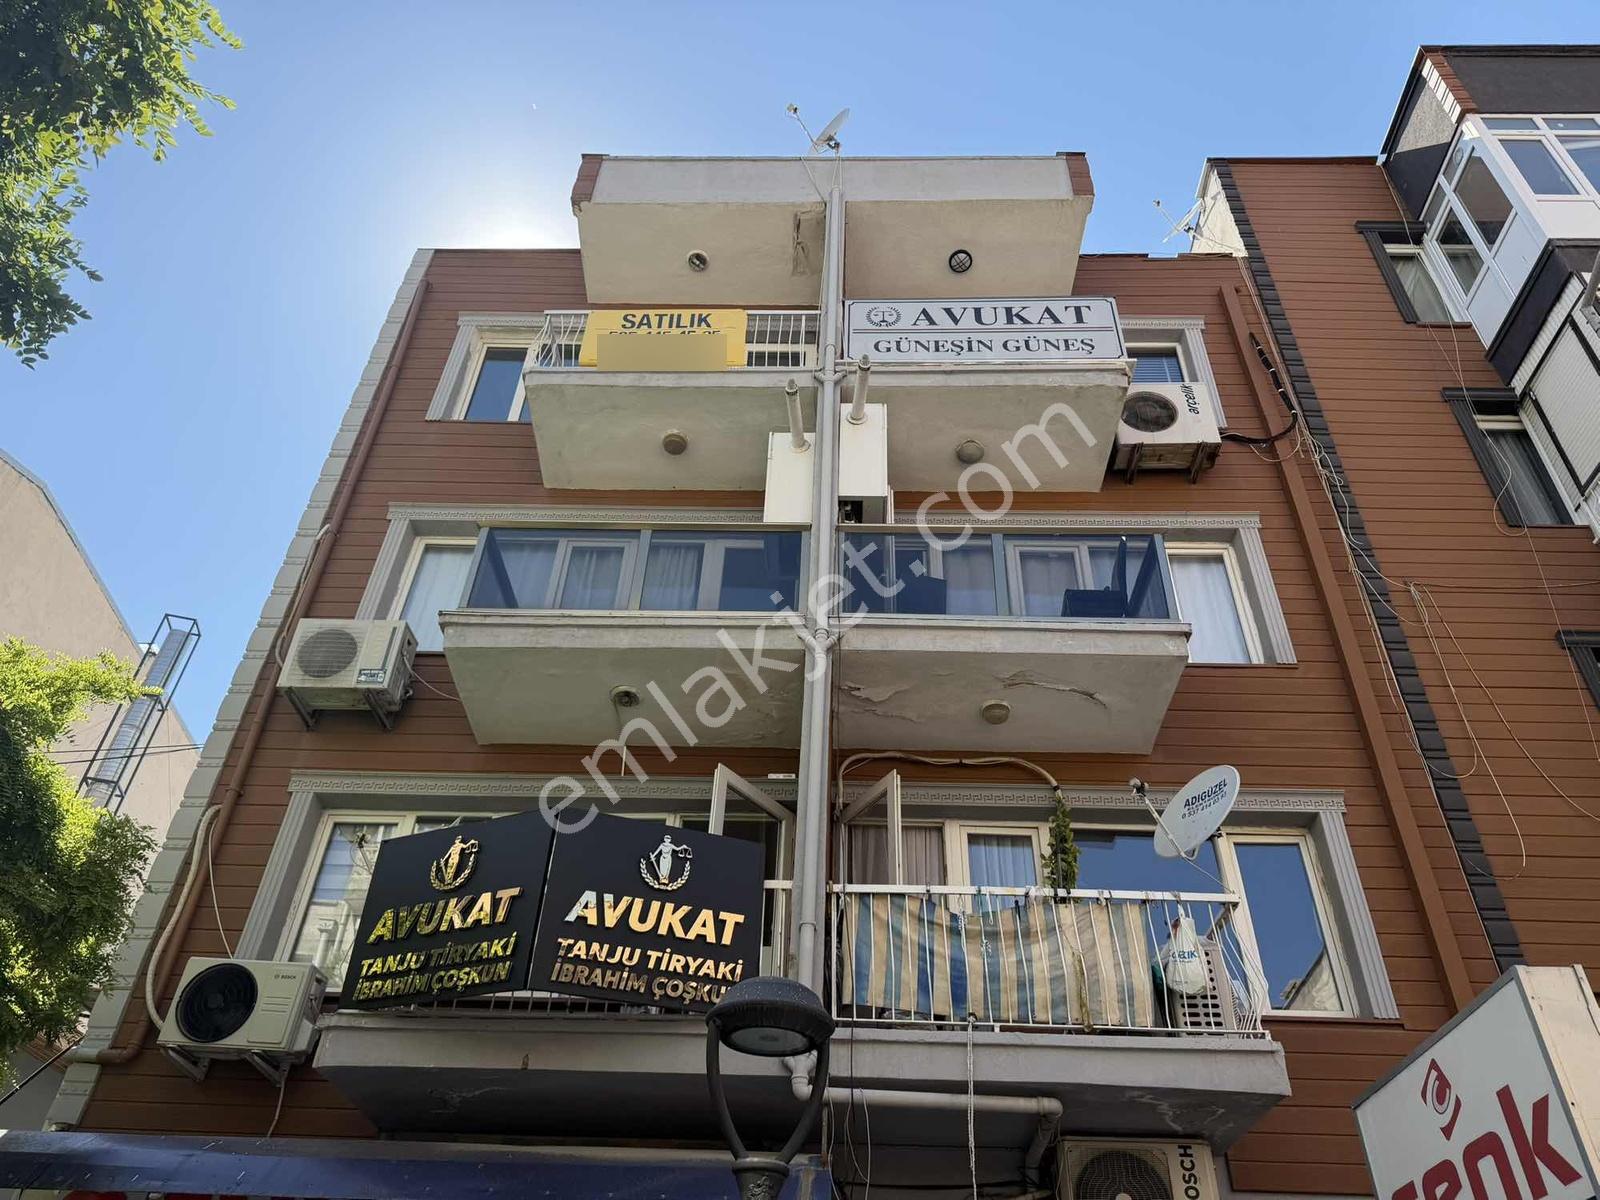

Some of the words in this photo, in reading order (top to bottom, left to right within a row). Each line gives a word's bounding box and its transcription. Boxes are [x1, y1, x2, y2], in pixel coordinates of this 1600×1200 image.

[621, 312, 713, 329] SATILIK
[912, 304, 1093, 327] AVUKAT
[873, 336, 994, 356] GÜNEŞİN
[1002, 335, 1096, 355] GÜNEŞ
[1183, 777, 1228, 809] ADIGÜZEL
[366, 886, 525, 945] AVUKAT
[564, 889, 746, 947] AVUKAT
[359, 951, 426, 978] TANJU
[428, 930, 518, 967] TİRYAKİ
[557, 937, 642, 966] TANJU
[646, 948, 745, 983] TİRYAKİ
[352, 970, 432, 1001] İBRAHİM
[430, 960, 514, 995] ÇOŞKUN
[550, 956, 649, 994] İBRAHİM
[651, 975, 732, 1005] ÇOŞKU
[1177, 1144, 1200, 1200] OSCH
